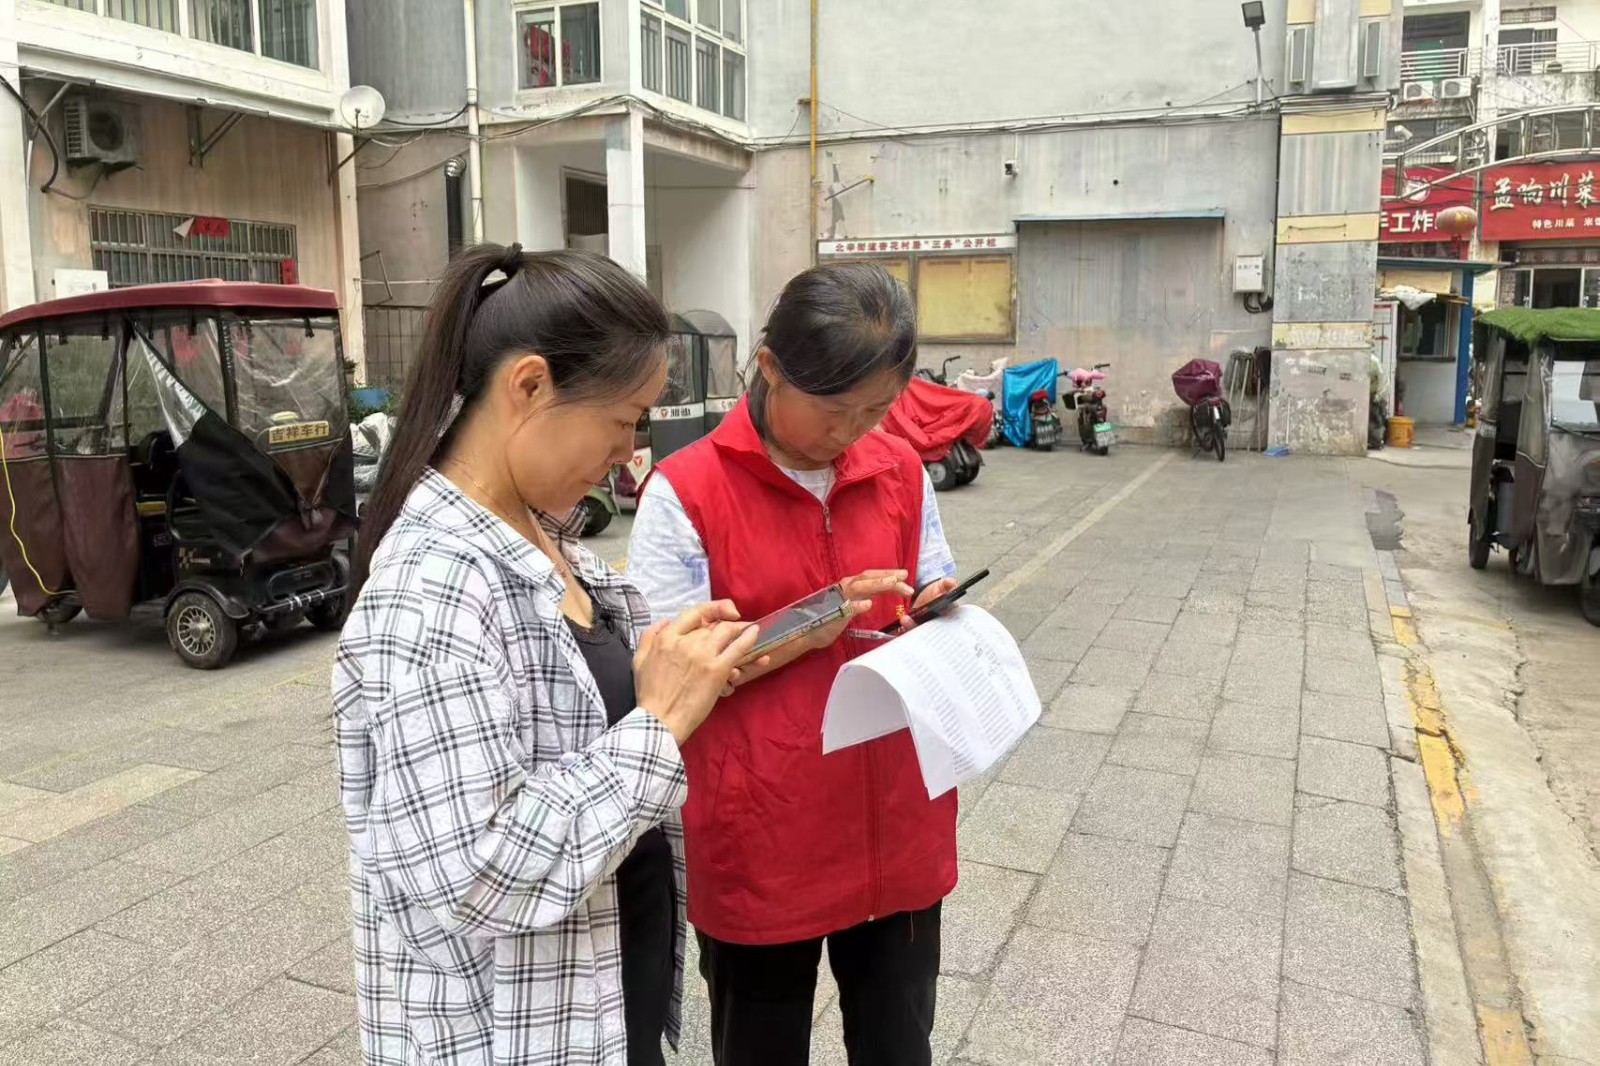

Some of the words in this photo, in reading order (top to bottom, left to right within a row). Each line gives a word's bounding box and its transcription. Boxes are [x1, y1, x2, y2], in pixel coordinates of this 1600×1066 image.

[1381, 210, 1439, 233] 工炸
[272, 422, 328, 442] 吉祥车行
